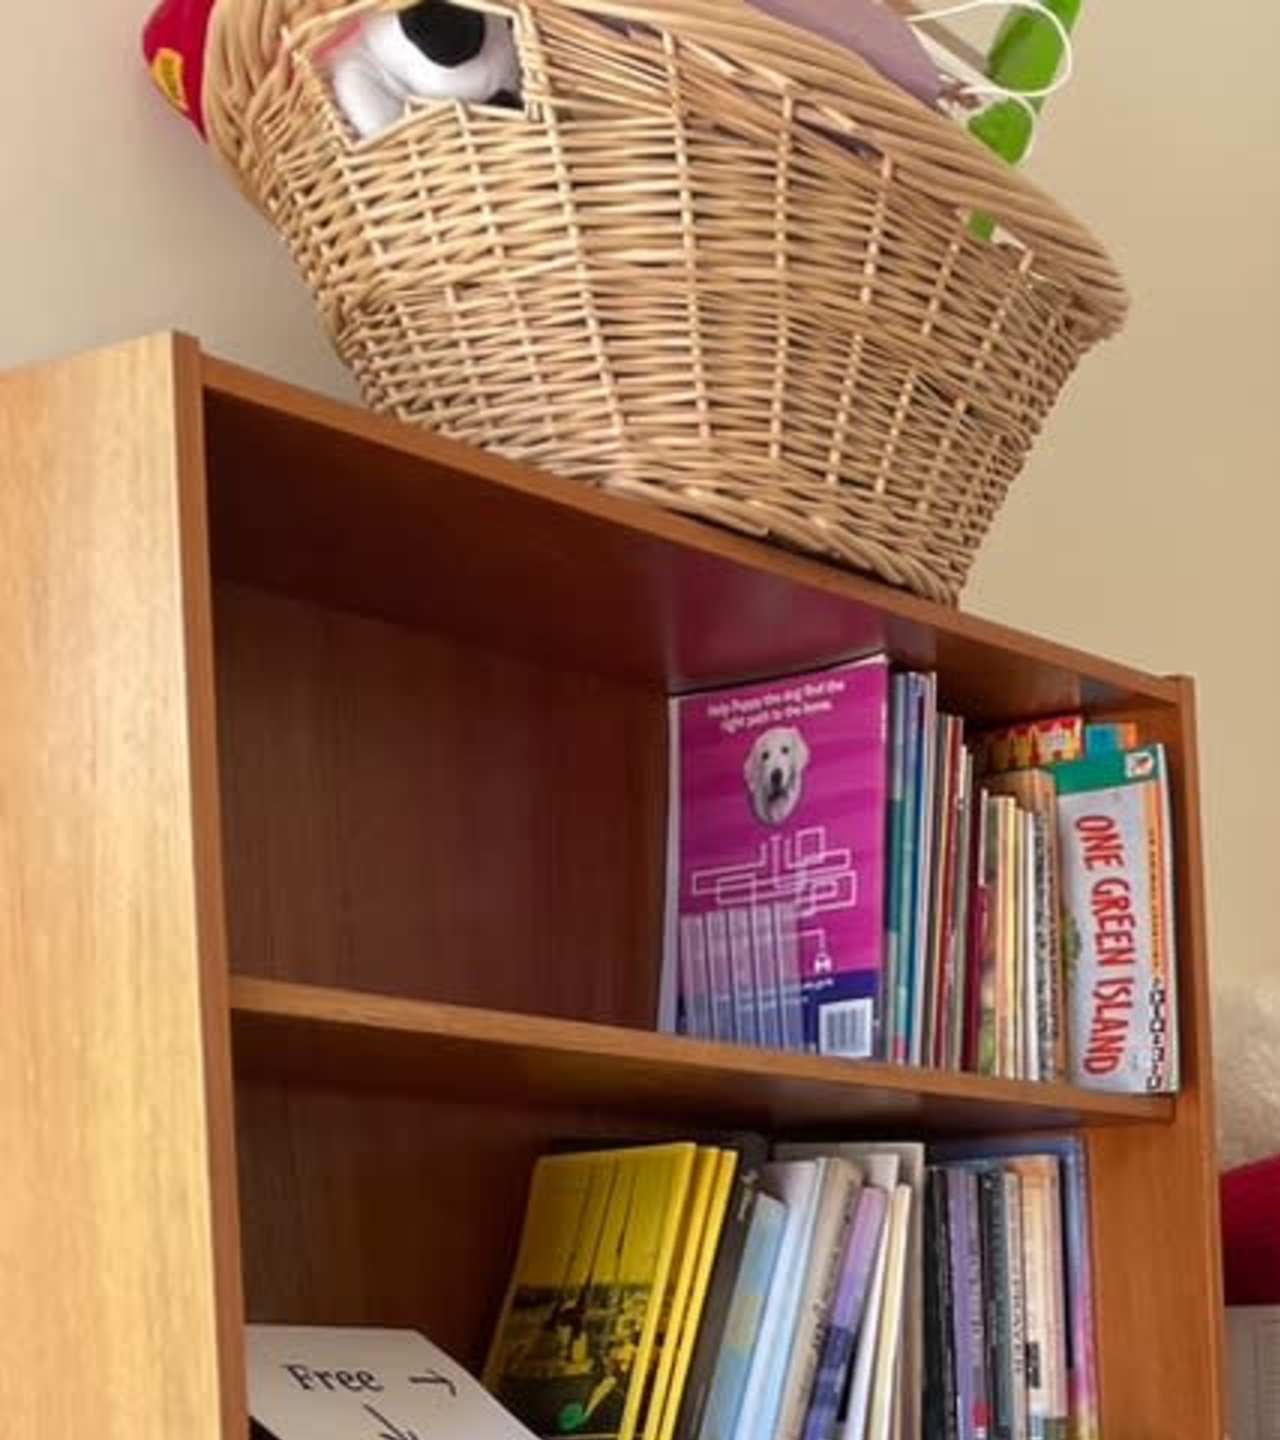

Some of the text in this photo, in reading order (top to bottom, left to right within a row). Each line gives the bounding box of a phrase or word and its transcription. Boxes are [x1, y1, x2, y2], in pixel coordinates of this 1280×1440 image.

[1074, 814, 1137, 1077] ONE GREEN ISLAND
[283, 1362, 385, 1394] Free
